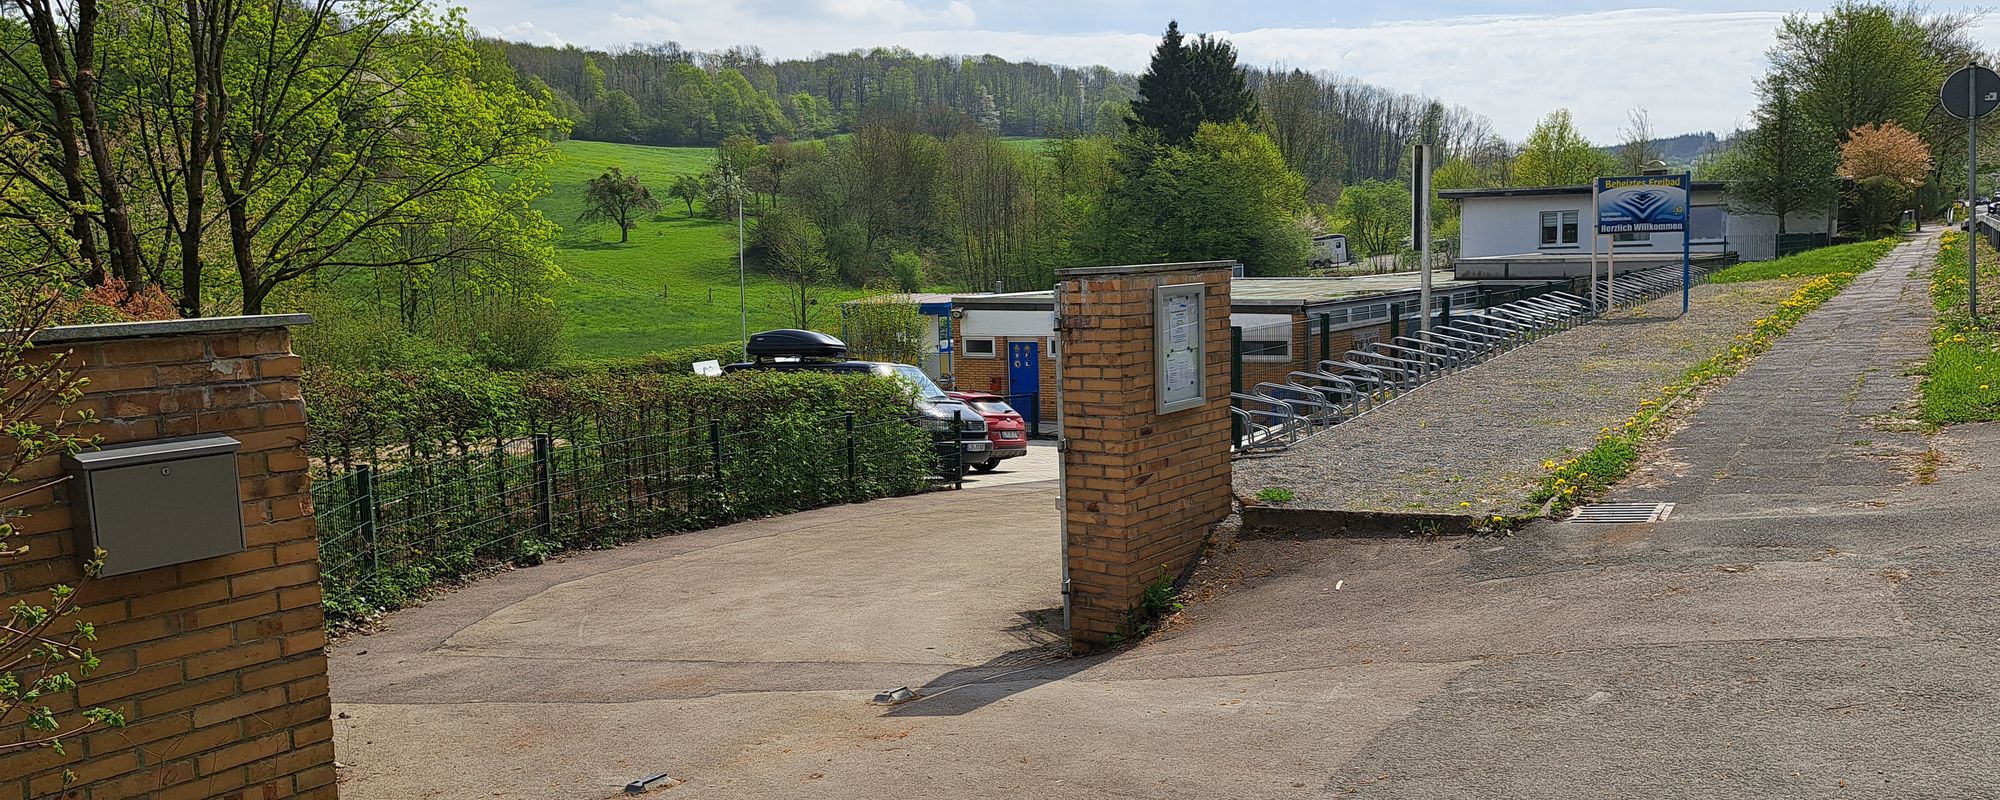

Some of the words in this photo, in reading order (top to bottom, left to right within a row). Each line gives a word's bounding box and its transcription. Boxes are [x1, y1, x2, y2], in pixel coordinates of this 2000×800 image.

[1605, 179, 1646, 189] Beheiztes
[1648, 177, 1681, 187] Freibad
[1601, 224, 1632, 233] Herzlich
[1633, 222, 1683, 232] Willkommen
